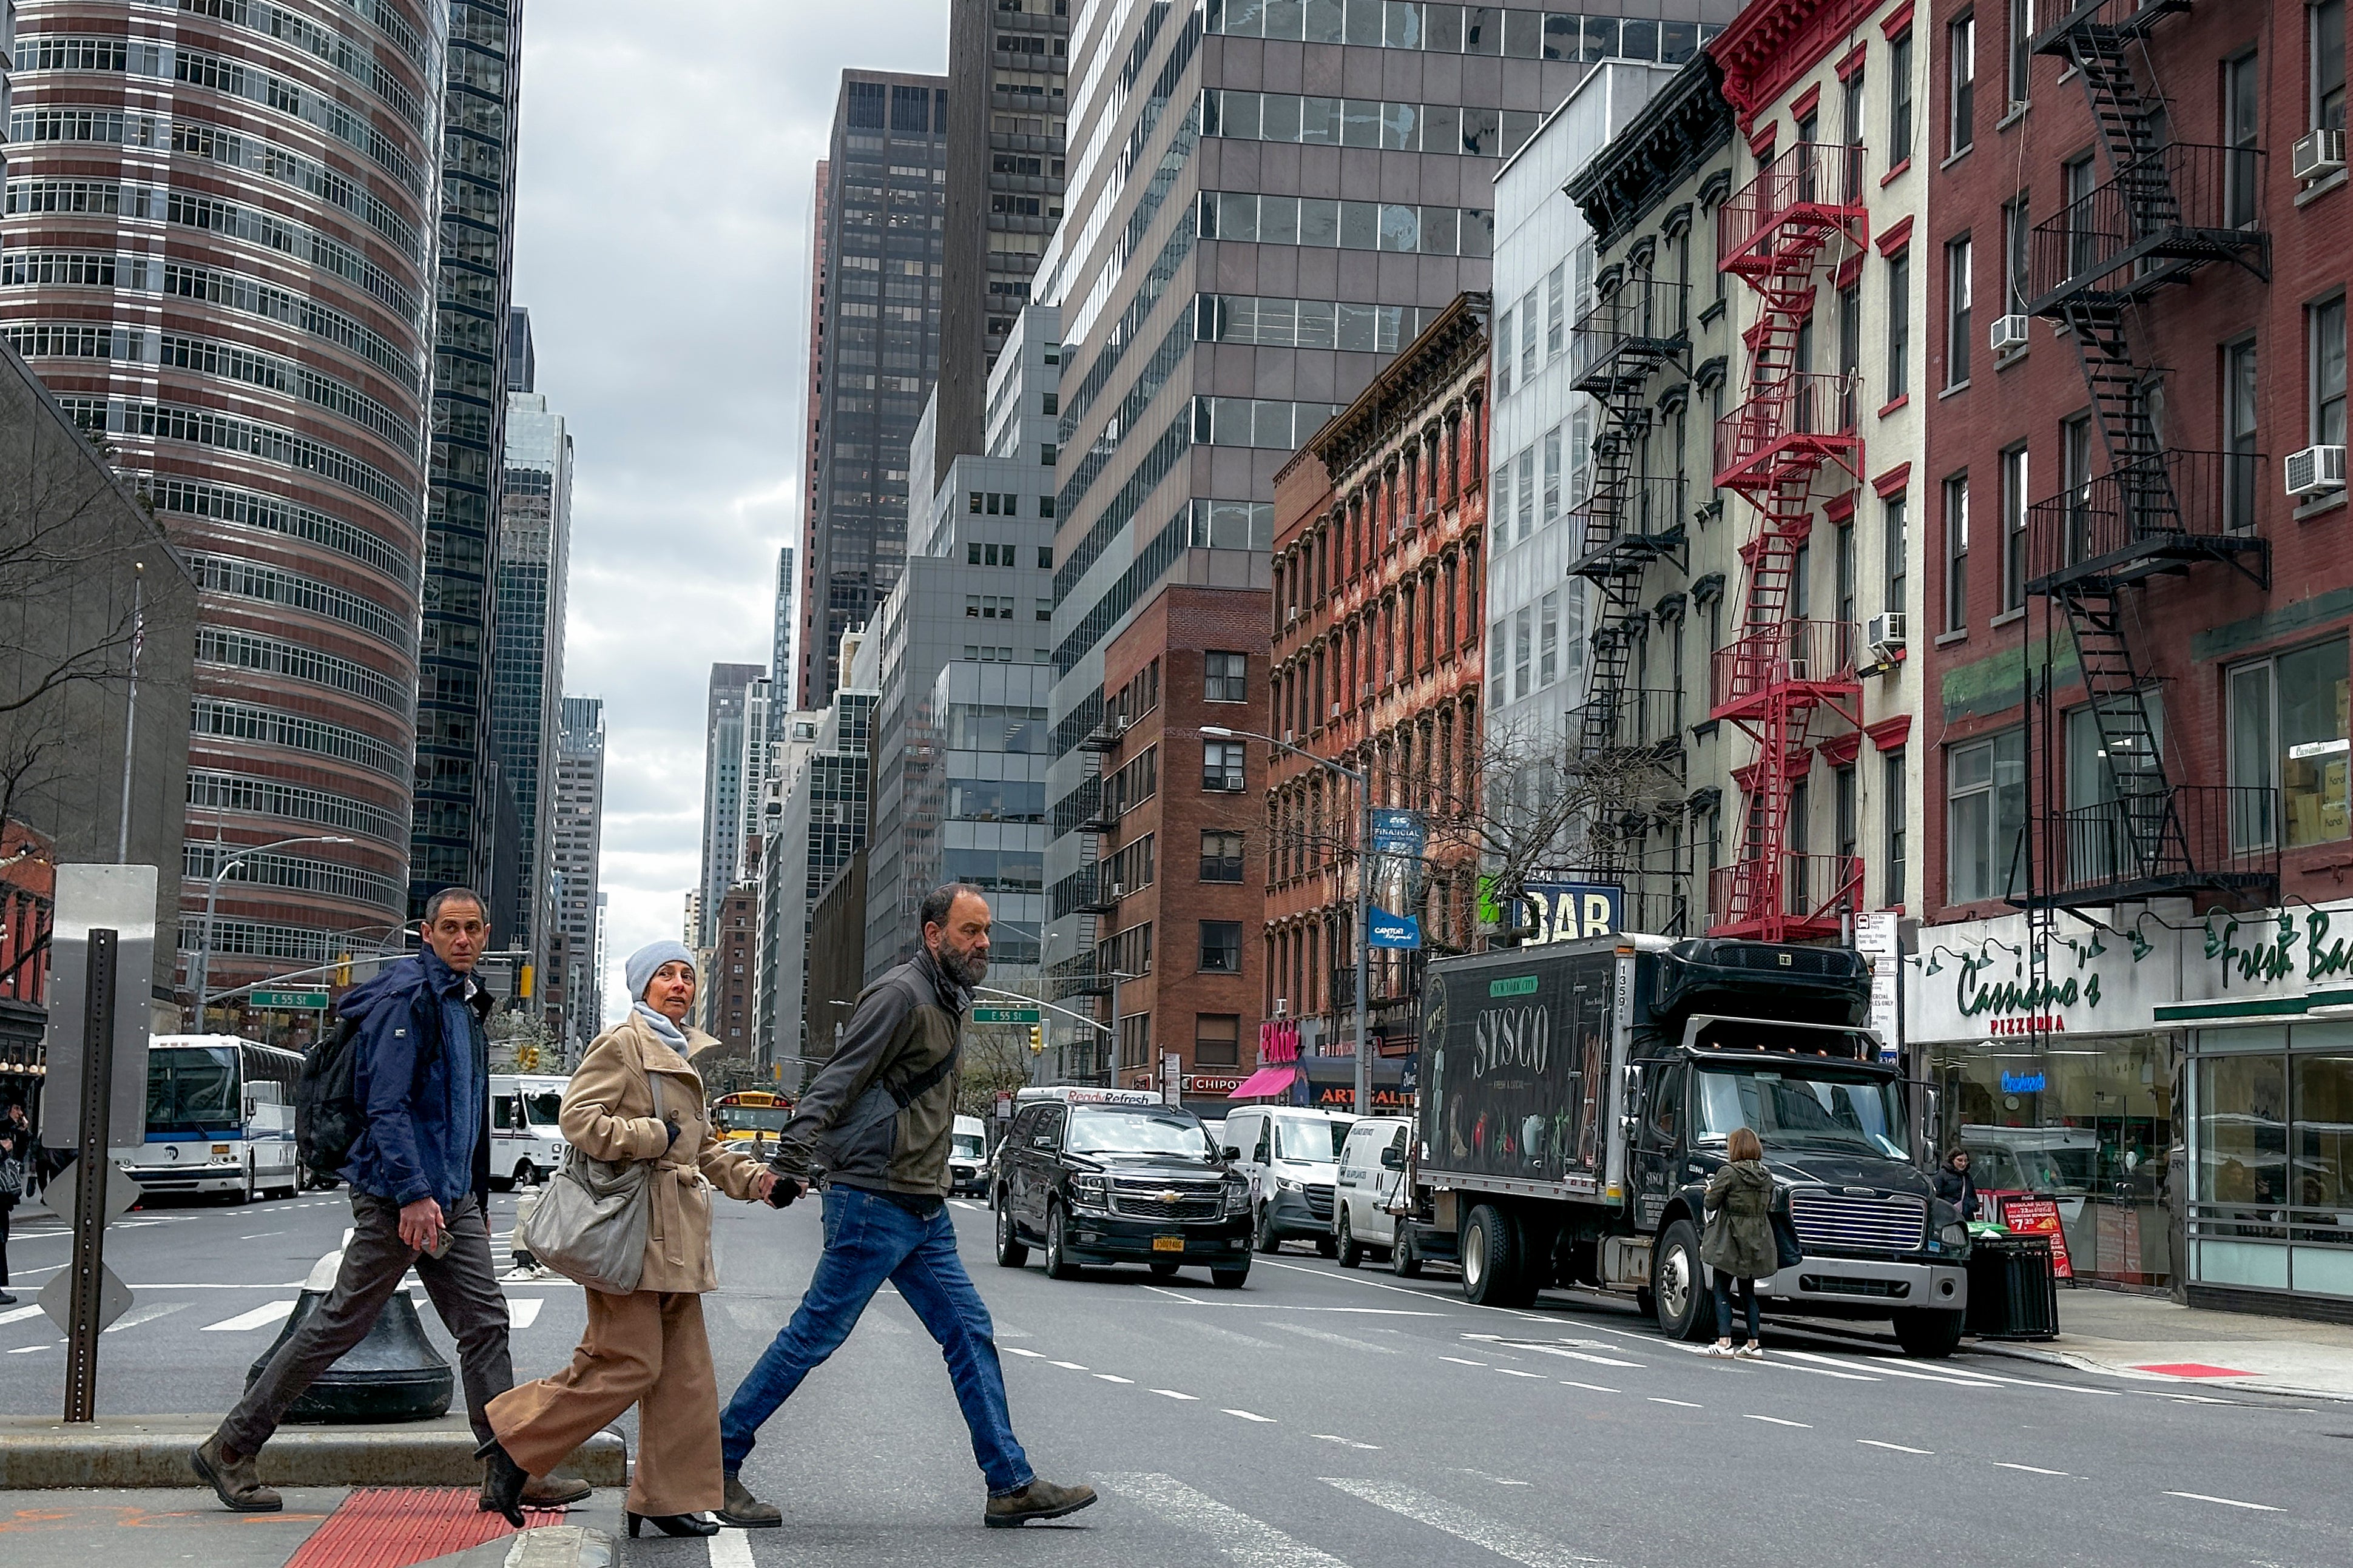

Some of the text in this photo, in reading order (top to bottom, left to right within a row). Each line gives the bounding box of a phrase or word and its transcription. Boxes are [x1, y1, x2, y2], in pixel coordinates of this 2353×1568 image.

[1522, 892, 1611, 946] BAR
[2221, 913, 2294, 989] Fresh
[272, 994, 306, 1005] E 55 St
[1957, 946, 2101, 1017] Cassiano's
[991, 1011, 1022, 1021] E 55 St
[1990, 1015, 2065, 1035] PIZZERIA
[1473, 1004, 1548, 1080] SYSCO
[1068, 1091, 1149, 1105] ReadyRefresh
